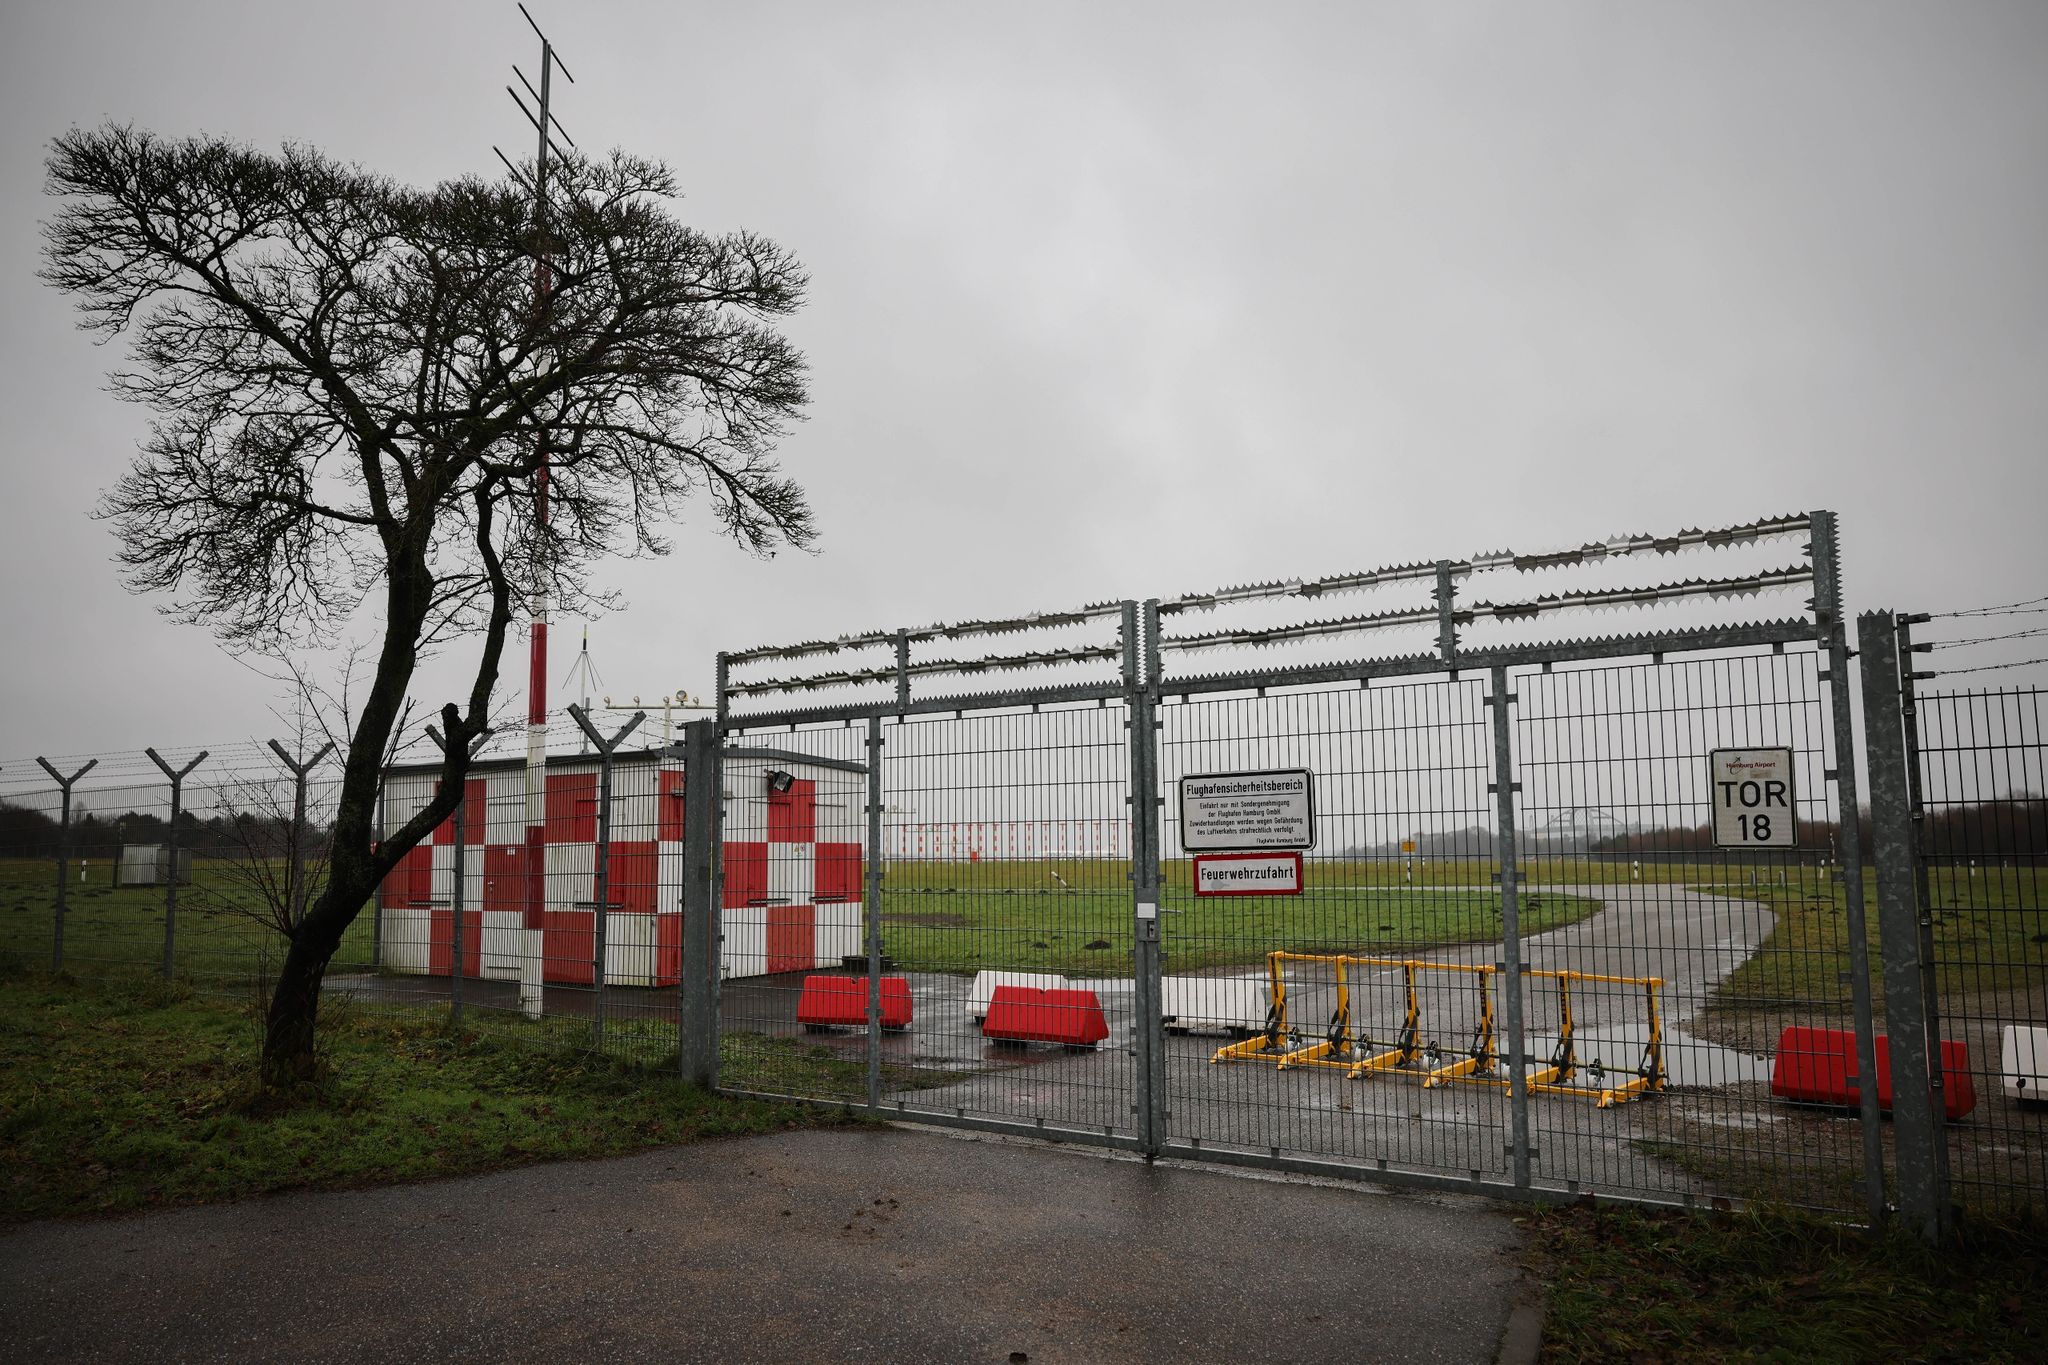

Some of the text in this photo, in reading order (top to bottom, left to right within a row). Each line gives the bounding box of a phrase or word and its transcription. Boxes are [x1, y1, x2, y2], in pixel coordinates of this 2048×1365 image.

[1186, 779, 1303, 797] Flughafensicherheitsbereich
[1718, 781, 1787, 808] TOR
[1189, 819, 1235, 827] Zuwiderhandlungen
[1738, 814, 1771, 841] 18
[1201, 866, 1294, 880] Feuerwehrzufahrt
